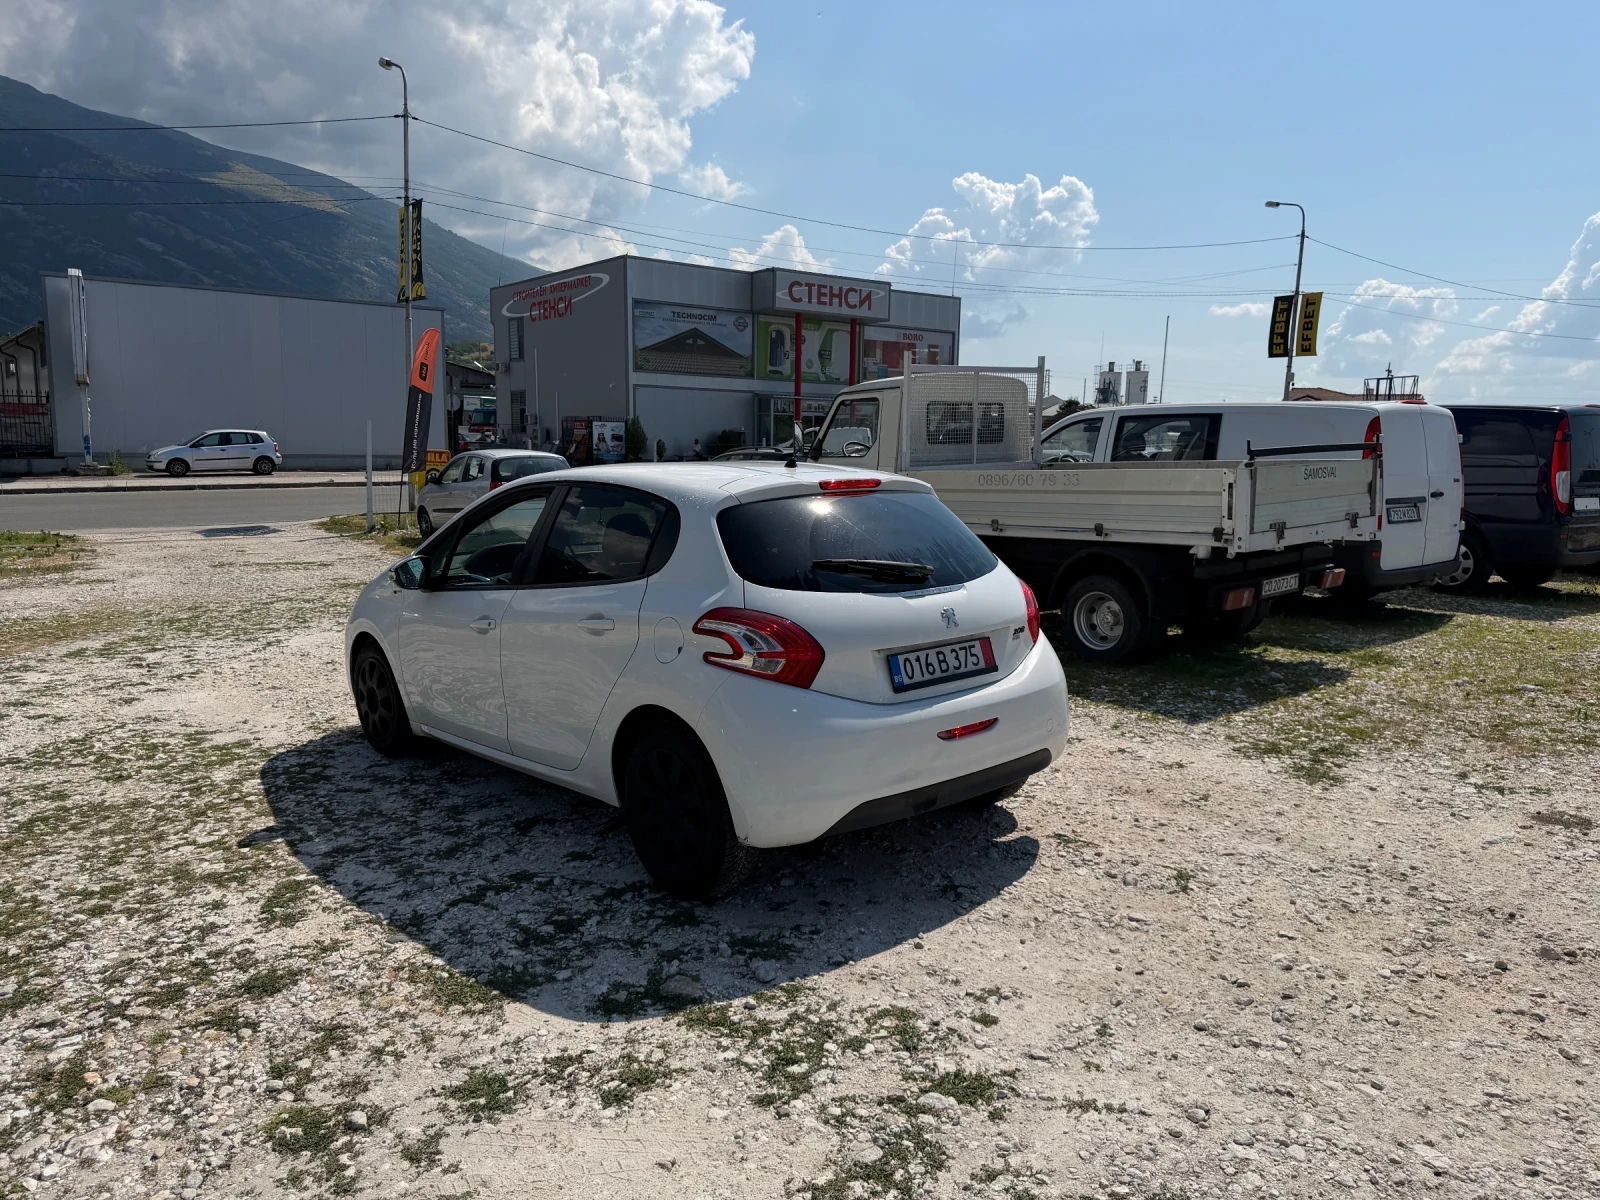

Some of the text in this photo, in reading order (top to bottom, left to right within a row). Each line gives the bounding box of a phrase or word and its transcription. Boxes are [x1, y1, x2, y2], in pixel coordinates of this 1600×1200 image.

[513, 275, 592, 302] СТРОИТЕЛЕН ХИПЕРМАРКЕТ
[788, 280, 873, 311] СТЕНСИ
[529, 296, 573, 322] СТЕНСИ
[671, 310, 717, 322] TECHNOCIM
[902, 332, 924, 342] BORO
[1272, 300, 1289, 354] EFBET
[1300, 297, 1317, 353] EFBET
[427, 452, 448, 463] ILLA
[978, 473, 1080, 487] 0896/60 79 33
